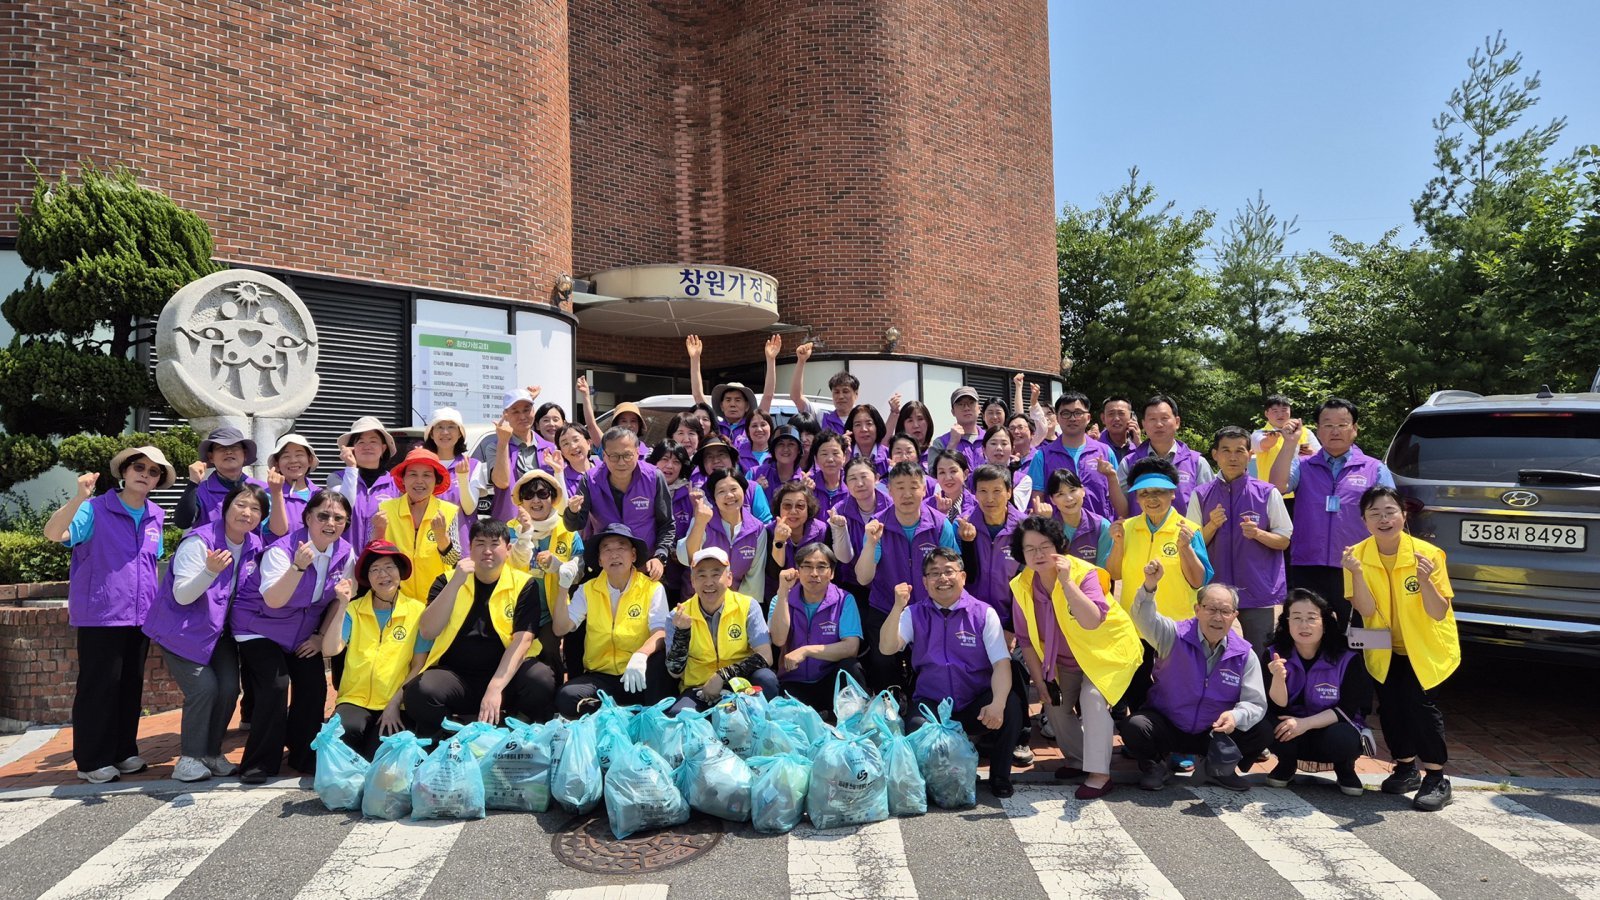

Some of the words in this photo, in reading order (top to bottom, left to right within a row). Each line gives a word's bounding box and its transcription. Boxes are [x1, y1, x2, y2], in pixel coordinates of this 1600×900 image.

[680, 268, 777, 304] 창원가정교
[1468, 524, 1520, 541] 358저
[1525, 526, 1577, 545] 8498
